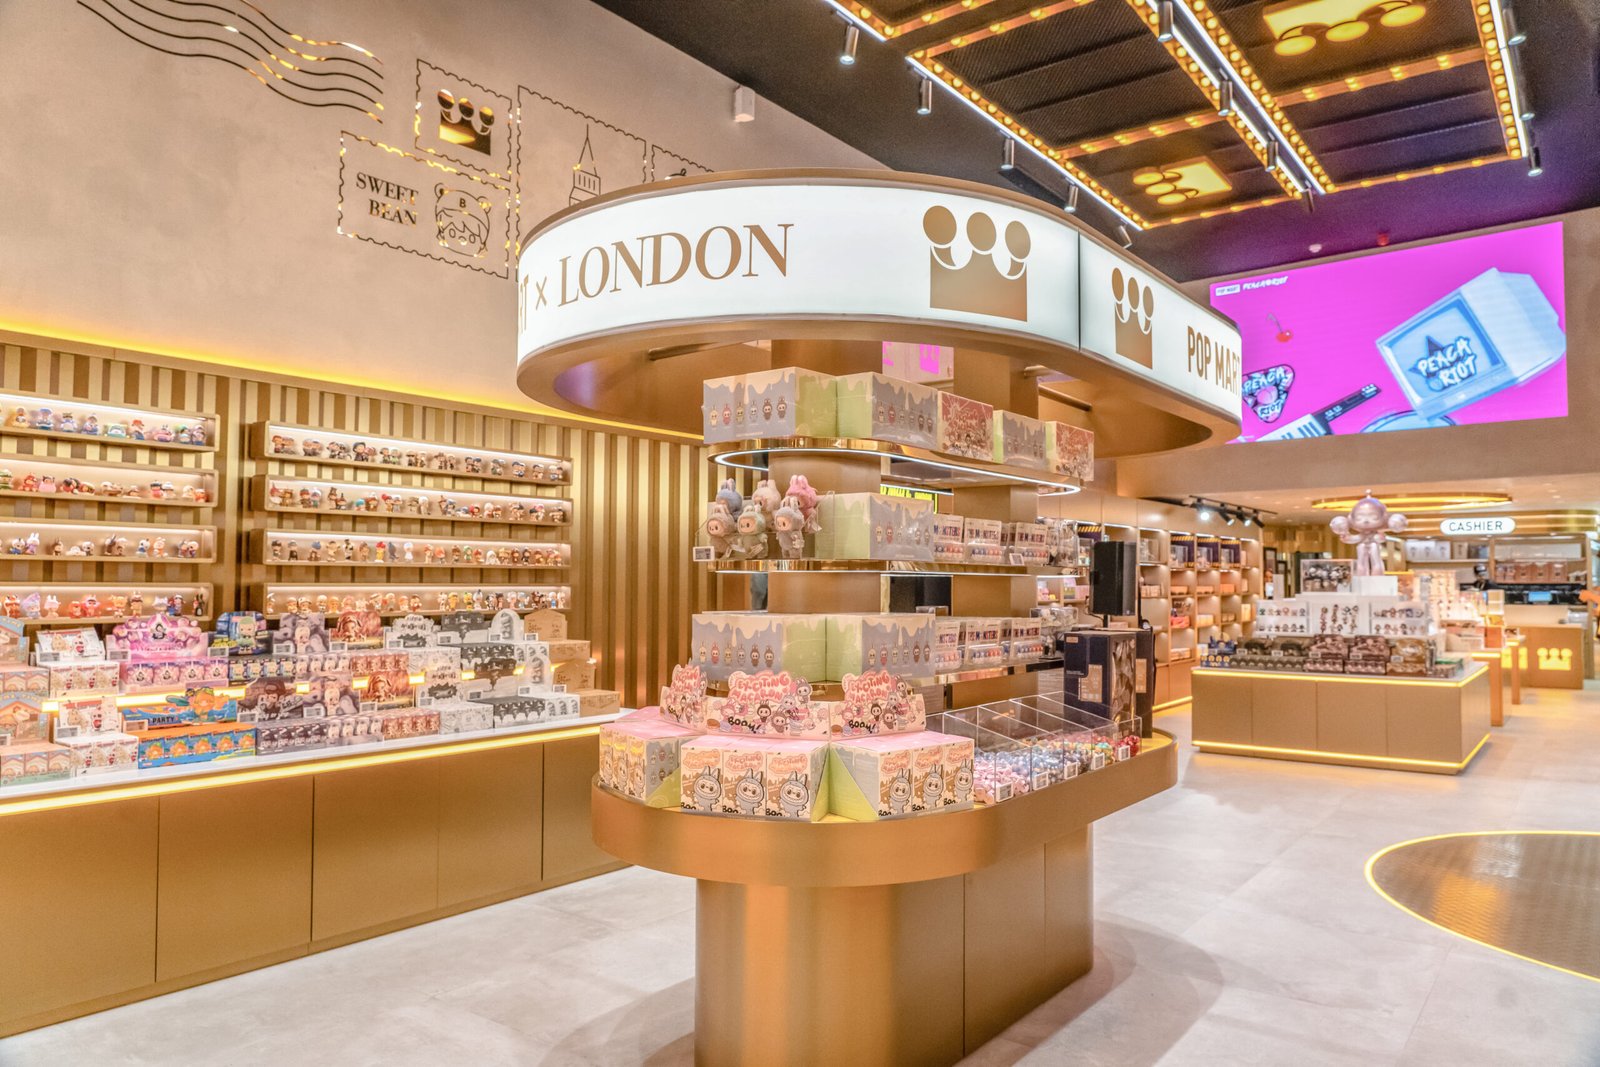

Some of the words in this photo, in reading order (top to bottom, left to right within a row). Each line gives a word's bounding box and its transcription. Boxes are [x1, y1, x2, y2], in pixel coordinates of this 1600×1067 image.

[356, 172, 419, 205] SWEET
[369, 199, 417, 228] BEAN
[459, 198, 467, 208] B
[558, 223, 794, 307] LONDON
[1188, 325, 1211, 380] POP
[1418, 338, 1472, 376] PEACH
[1243, 366, 1285, 393] PEACH
[1440, 355, 1476, 386] RIOT
[1260, 401, 1283, 416] RIOT
[1449, 520, 1503, 531] CASHIER
[738, 673, 789, 691] EXCITING
[851, 671, 890, 693] EXCITING
[152, 716, 175, 724] PARTY
[727, 716, 761, 733] BOOM!
[848, 719, 876, 734] BOOM!
